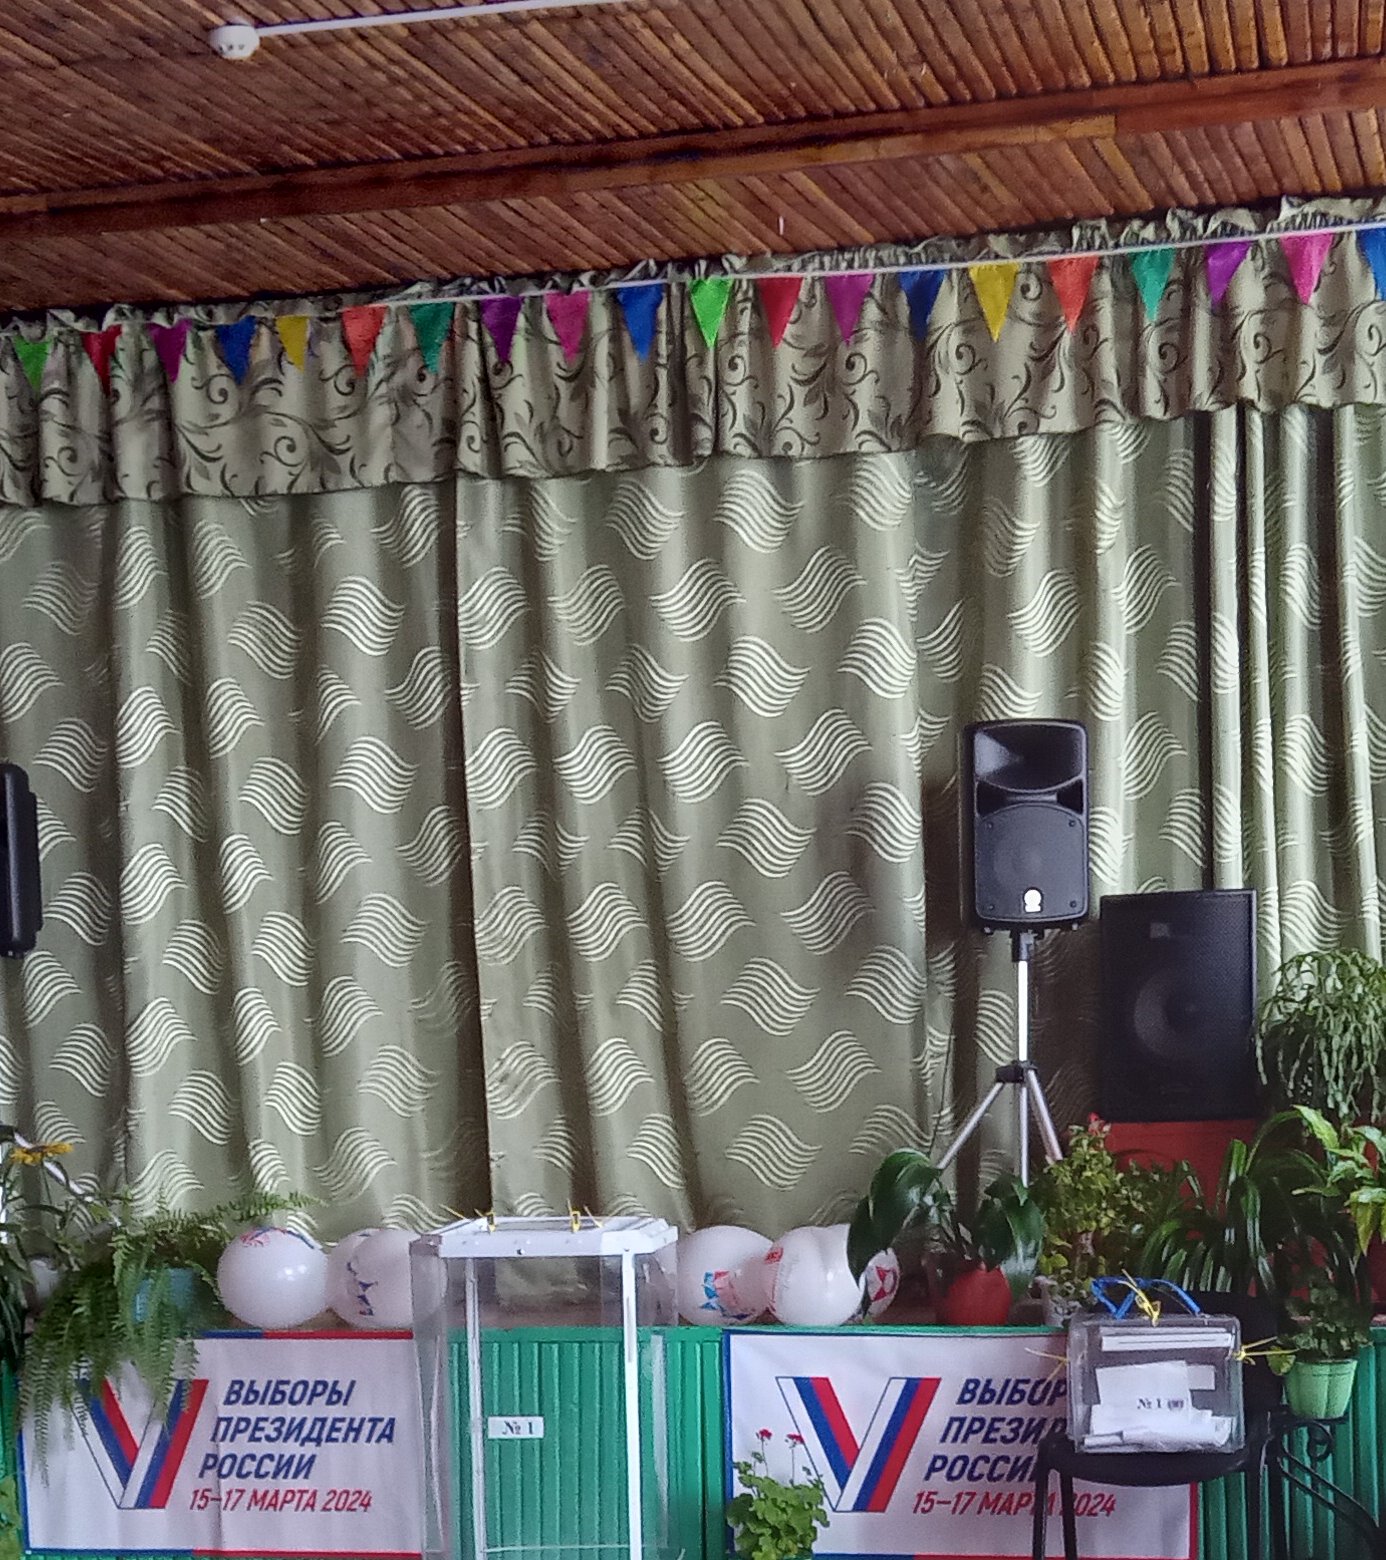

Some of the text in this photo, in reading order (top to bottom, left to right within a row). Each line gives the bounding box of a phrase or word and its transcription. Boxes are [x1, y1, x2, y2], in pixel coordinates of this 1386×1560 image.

[223, 1379, 356, 1406] ВЫБОРЫ
[1136, 1398, 1152, 1409] №
[210, 1416, 396, 1447] ПРЕЗИДЕНТА
[501, 1421, 534, 1435] № 1
[198, 1453, 317, 1480] РОССИИ
[923, 1454, 1036, 1482] РОССИ
[246, 1488, 317, 1512] МАРТА
[320, 1489, 372, 1513] 2024
[977, 1491, 1056, 1516] МАР
[1059, 1493, 1116, 1517] 024
